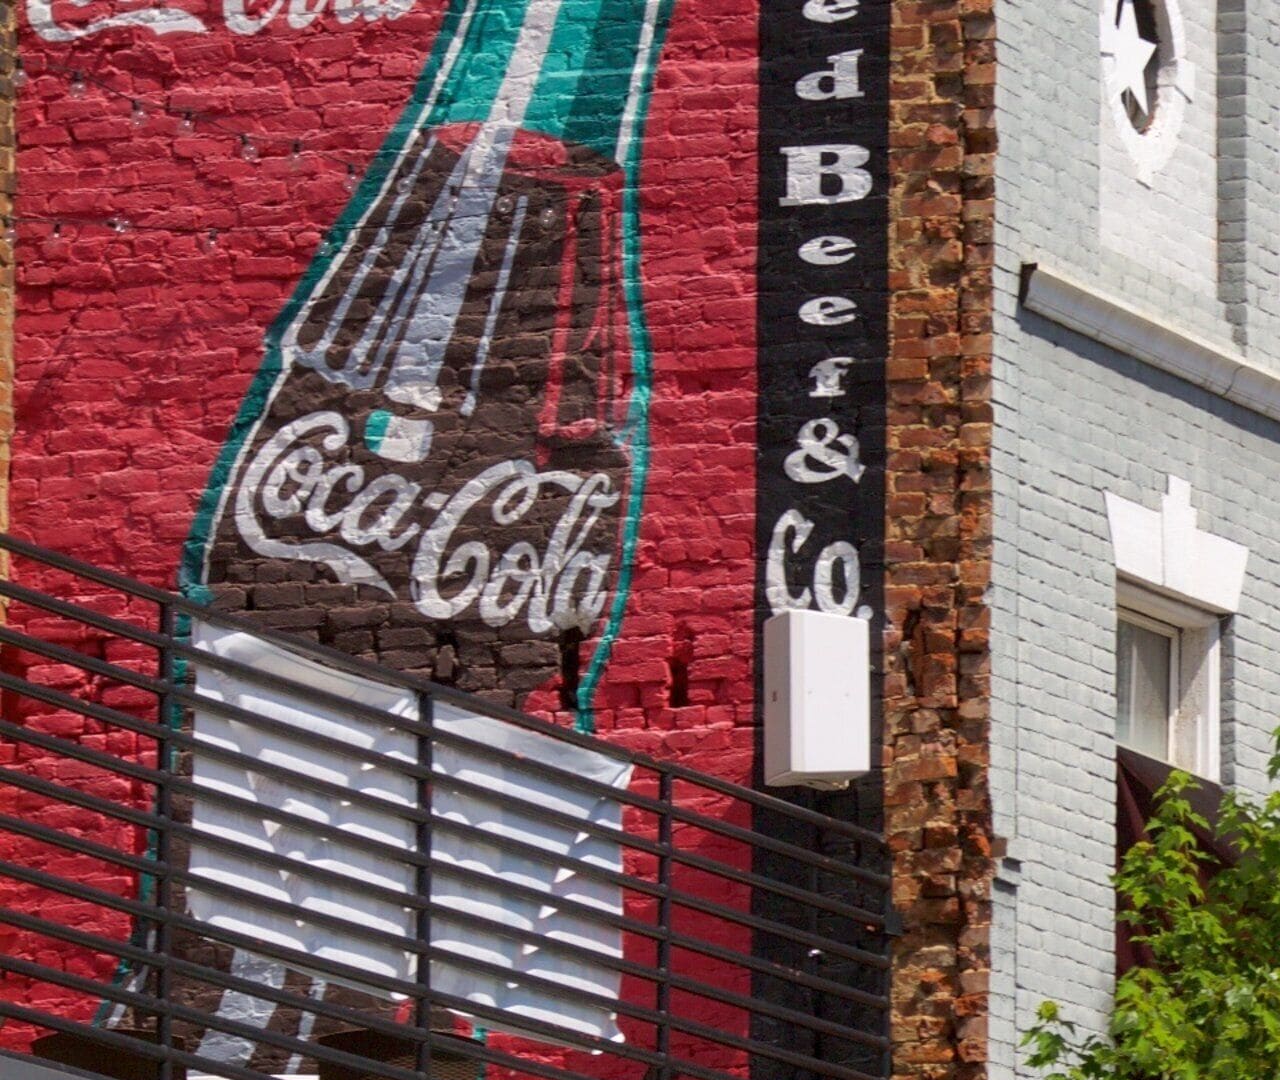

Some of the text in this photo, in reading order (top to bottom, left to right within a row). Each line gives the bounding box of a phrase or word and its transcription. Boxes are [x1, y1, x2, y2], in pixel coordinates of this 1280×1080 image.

[784, 417, 866, 483] &
[235, 410, 620, 633] Coca-Cola
[765, 508, 874, 617] Co.
